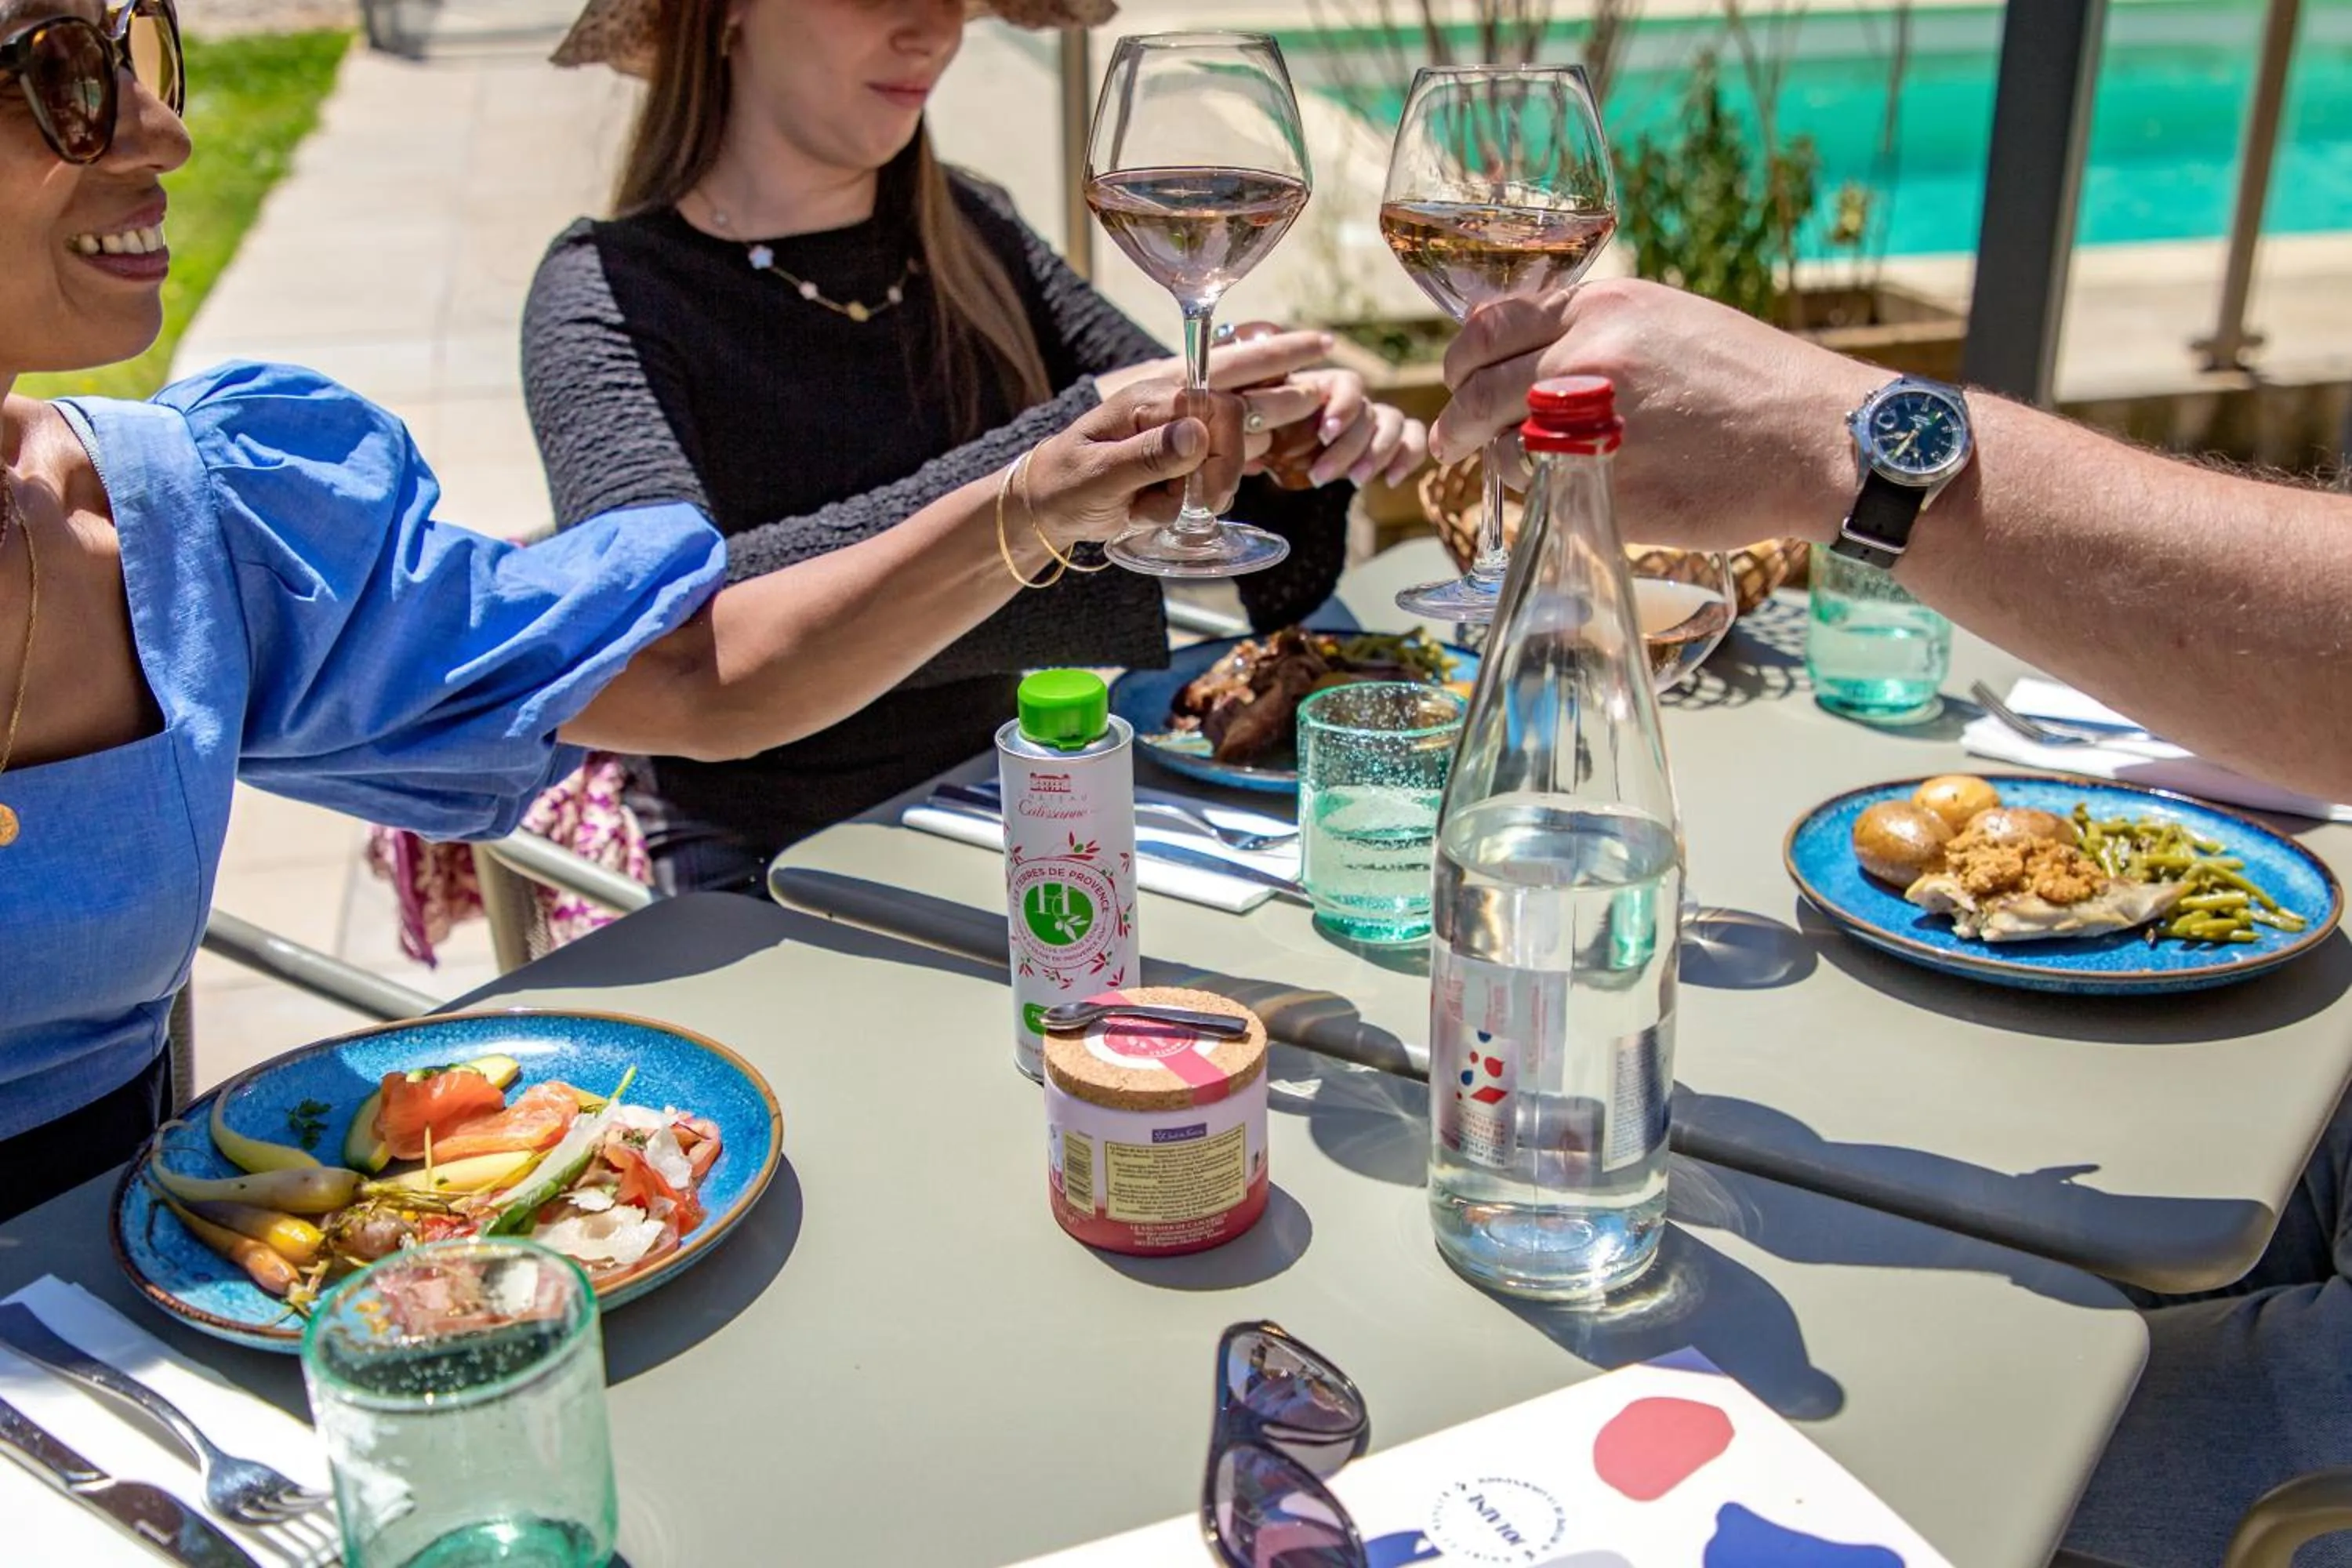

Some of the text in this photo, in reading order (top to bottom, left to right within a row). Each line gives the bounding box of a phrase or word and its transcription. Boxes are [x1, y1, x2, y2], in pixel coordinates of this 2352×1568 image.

[1015, 867, 1045, 887] TERRES
[1048, 867, 1065, 877] DE
[1069, 869, 1110, 914] PROVENCE
